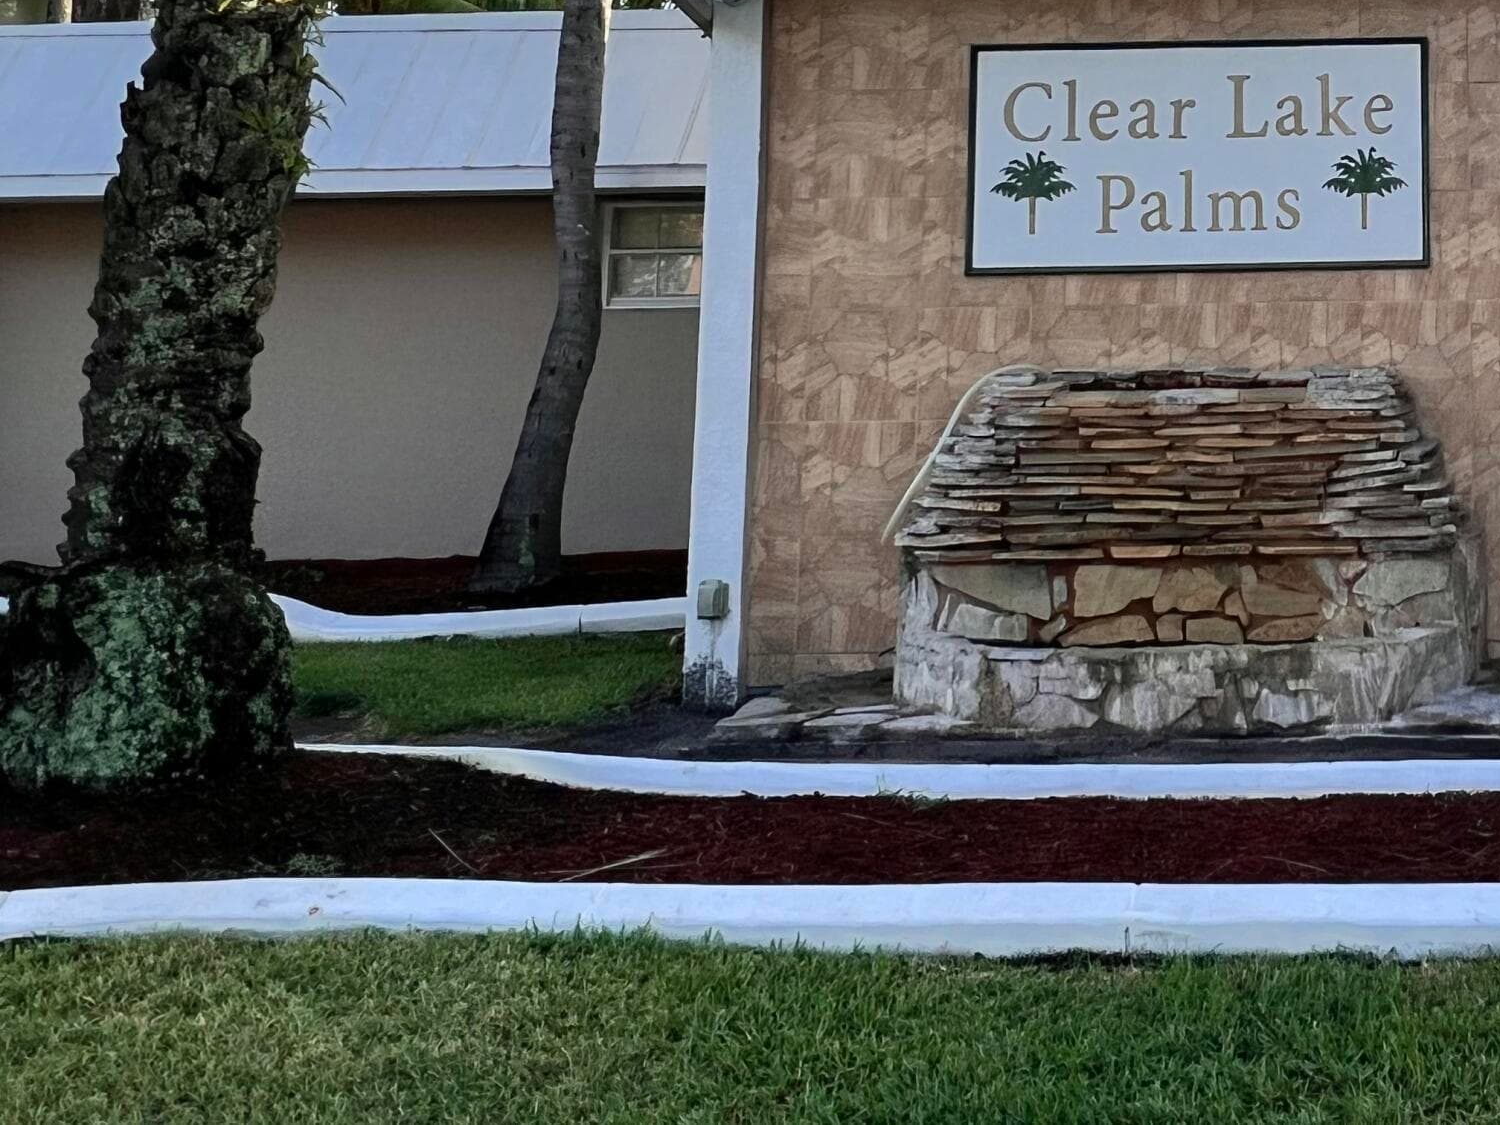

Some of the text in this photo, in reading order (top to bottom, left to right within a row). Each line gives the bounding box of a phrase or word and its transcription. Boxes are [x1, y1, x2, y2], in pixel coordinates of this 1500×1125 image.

[1003, 73, 1394, 142] Clear Lake
[1095, 169, 1301, 234] Palms
